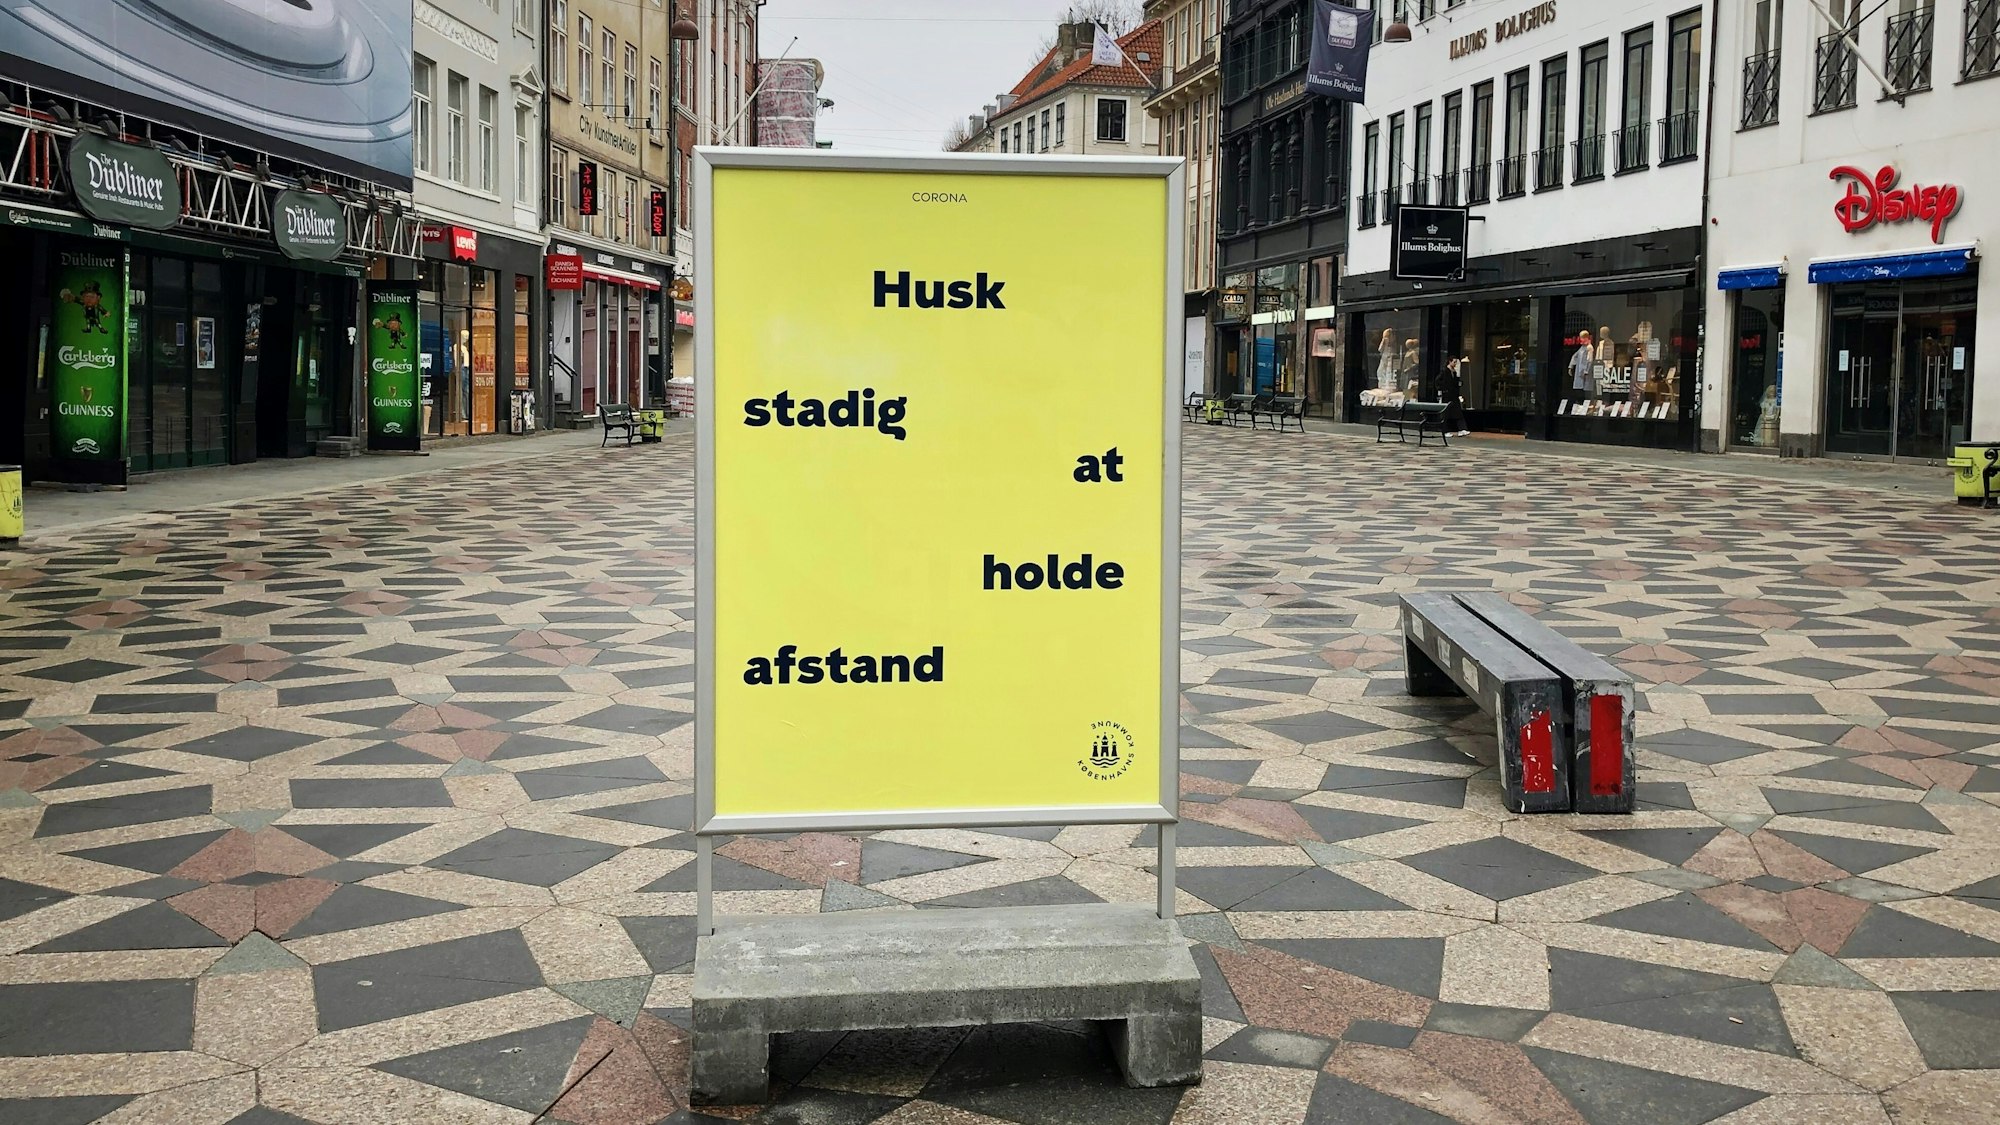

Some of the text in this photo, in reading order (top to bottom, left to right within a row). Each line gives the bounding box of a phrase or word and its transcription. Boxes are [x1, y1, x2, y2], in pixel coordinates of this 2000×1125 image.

[1340, 38, 1352, 46] FREE
[1449, 0, 1557, 61] ILLUMS BOLIGHUS
[1308, 74, 1333, 87] Illums
[1333, 79, 1363, 92] Bolighus
[579, 114, 592, 140] City
[100, 153, 111, 165] The
[85, 151, 163, 201] Dubliner
[580, 165, 592, 214] Art Shop
[911, 191, 967, 204] CORONA
[285, 206, 336, 237] Dubliner
[653, 206, 663, 235] Floor
[60, 252, 116, 268] Dubliner
[1401, 241, 1461, 254] Illums Bolighus
[372, 292, 411, 303] Dubliner
[873, 270, 1007, 310] Husk
[58, 345, 116, 370] Carlsberg
[372, 358, 413, 375] Carlsberg
[475, 355, 494, 372] SALE
[1603, 366, 1631, 383] SALE
[59, 402, 114, 418] GUINNESS
[373, 396, 412, 408] GUINNESS
[743, 387, 908, 441] stadig
[1072, 446, 1124, 483] at
[983, 553, 1125, 591] holde
[743, 645, 944, 686] afstand
[1090, 720, 1135, 748] KOMMUNE
